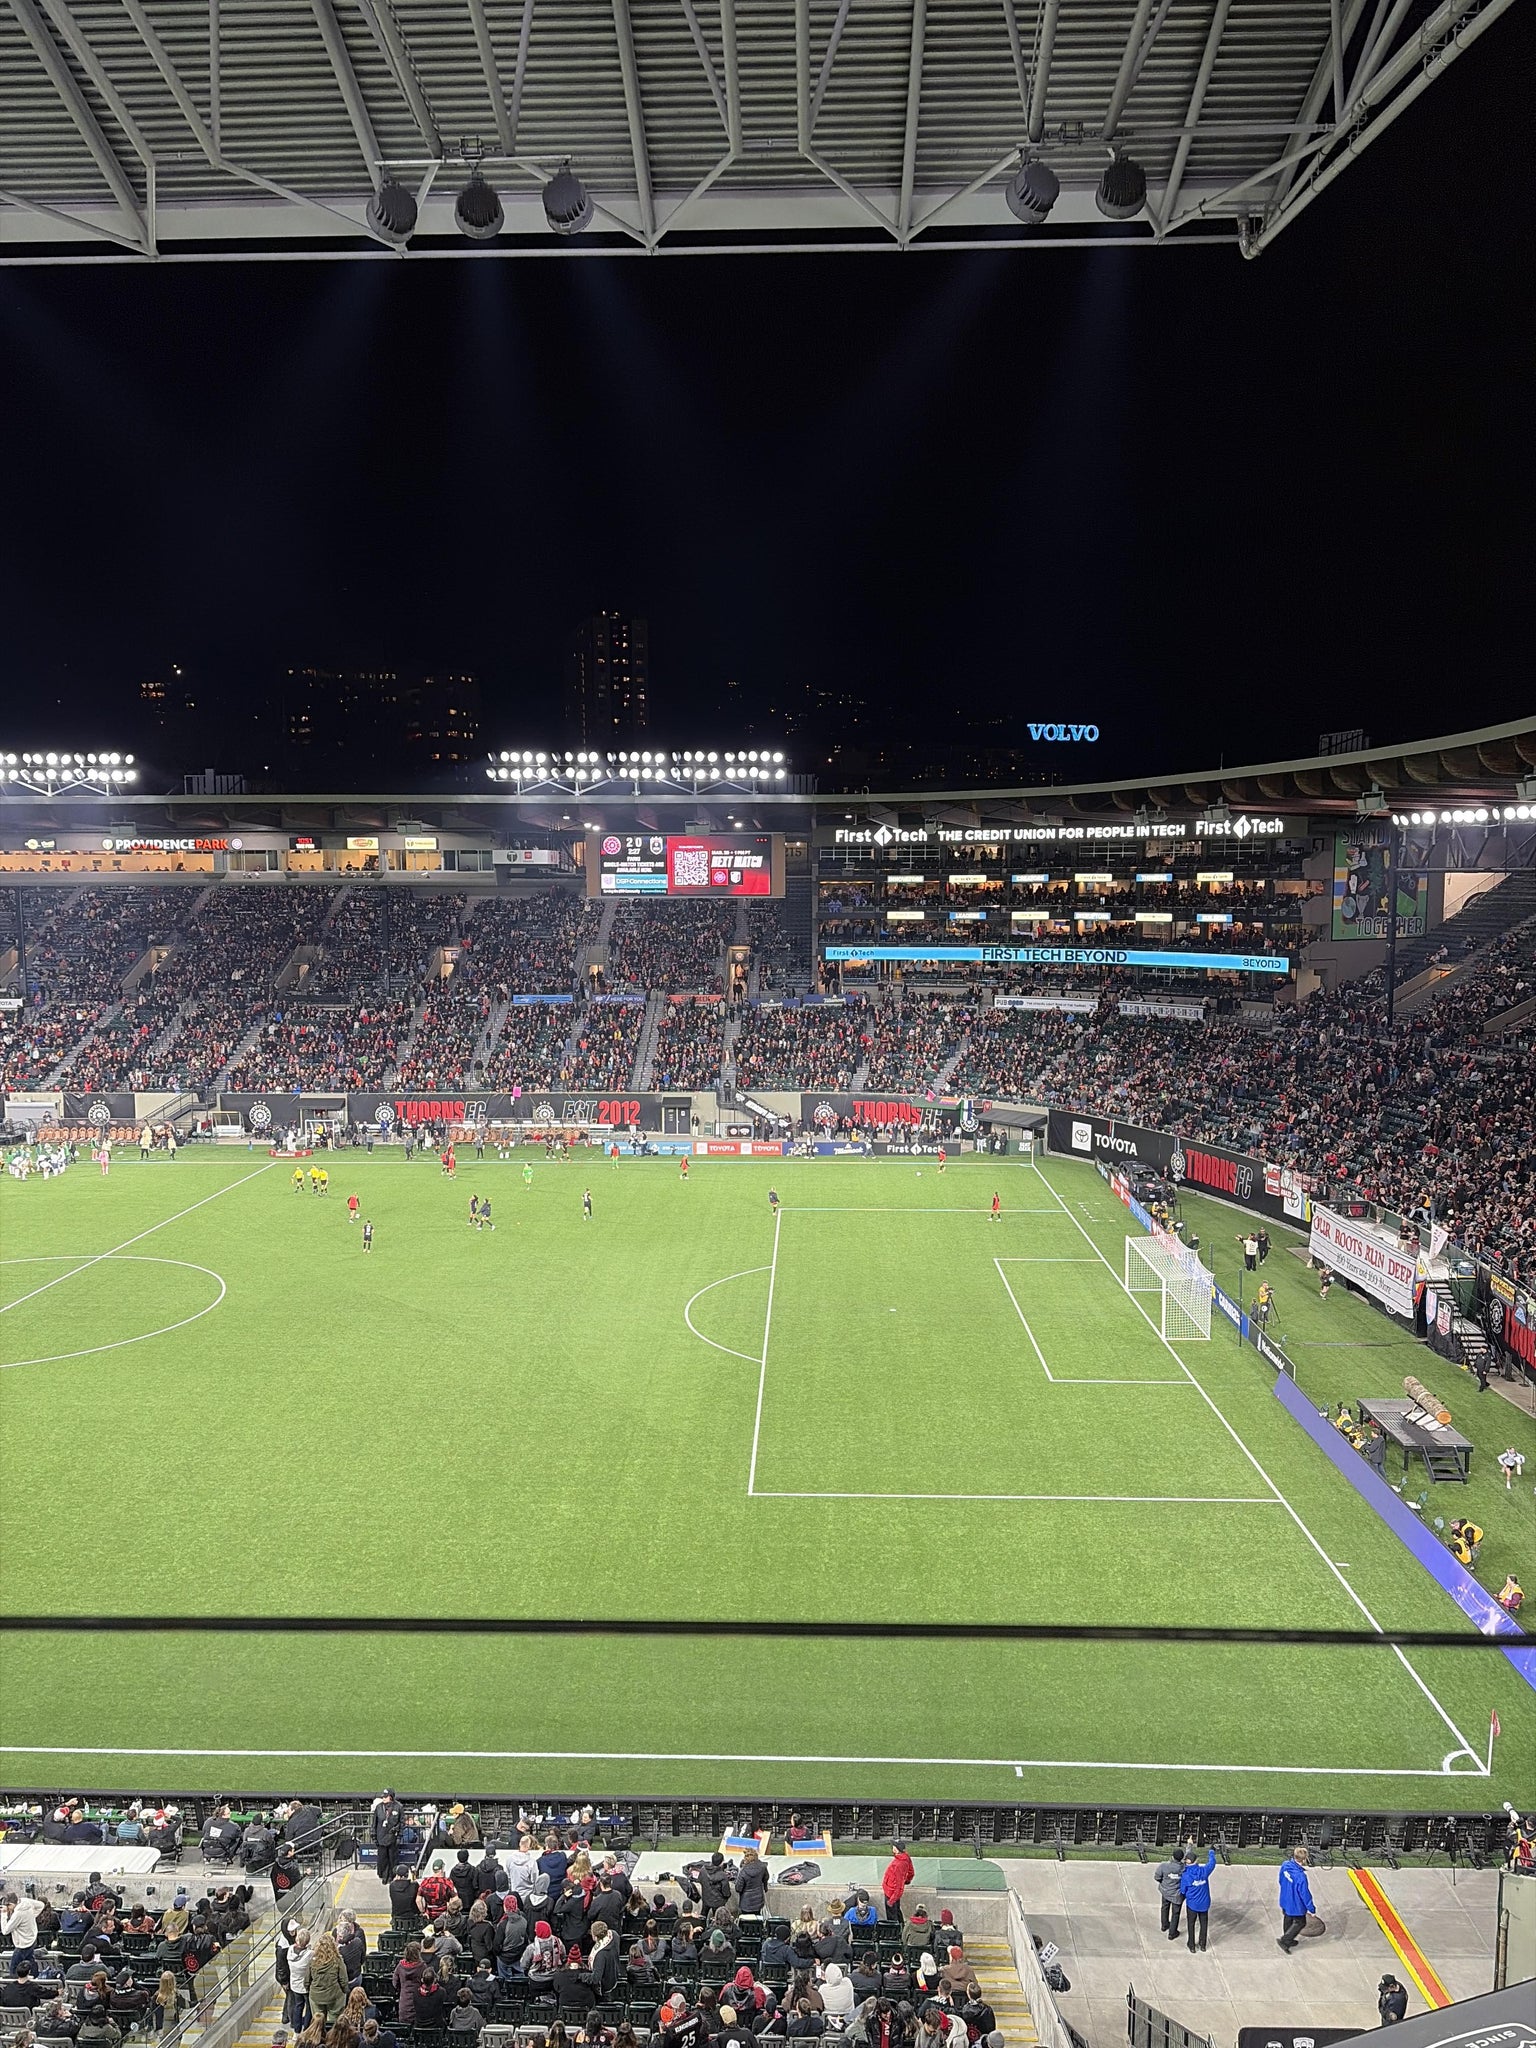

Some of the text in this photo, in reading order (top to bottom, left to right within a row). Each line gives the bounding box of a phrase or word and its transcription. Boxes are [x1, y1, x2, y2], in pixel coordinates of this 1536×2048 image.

[1027, 723, 1099, 742] VOLVO
[835, 828, 928, 842] First Tech
[938, 824, 1186, 841] THE CREDIT UNION FOR PEOPLE IN TECH
[1195, 817, 1283, 835] First Tech
[711, 856, 733, 868] NEXT
[1356, 917, 1423, 937] TOGEHER
[982, 948, 1127, 963] FIRST TECH BEYOND
[1242, 958, 1282, 969] BEYOND
[599, 1100, 641, 1125] 2012
[887, 1144, 909, 1154] First
[1094, 1133, 1138, 1156] TOYOTA
[1313, 1215, 1412, 1284] OUR ROOTS RUN DEEP
[681, 2030, 696, 2048] 25
[1464, 2030, 1517, 2048] SINCE
